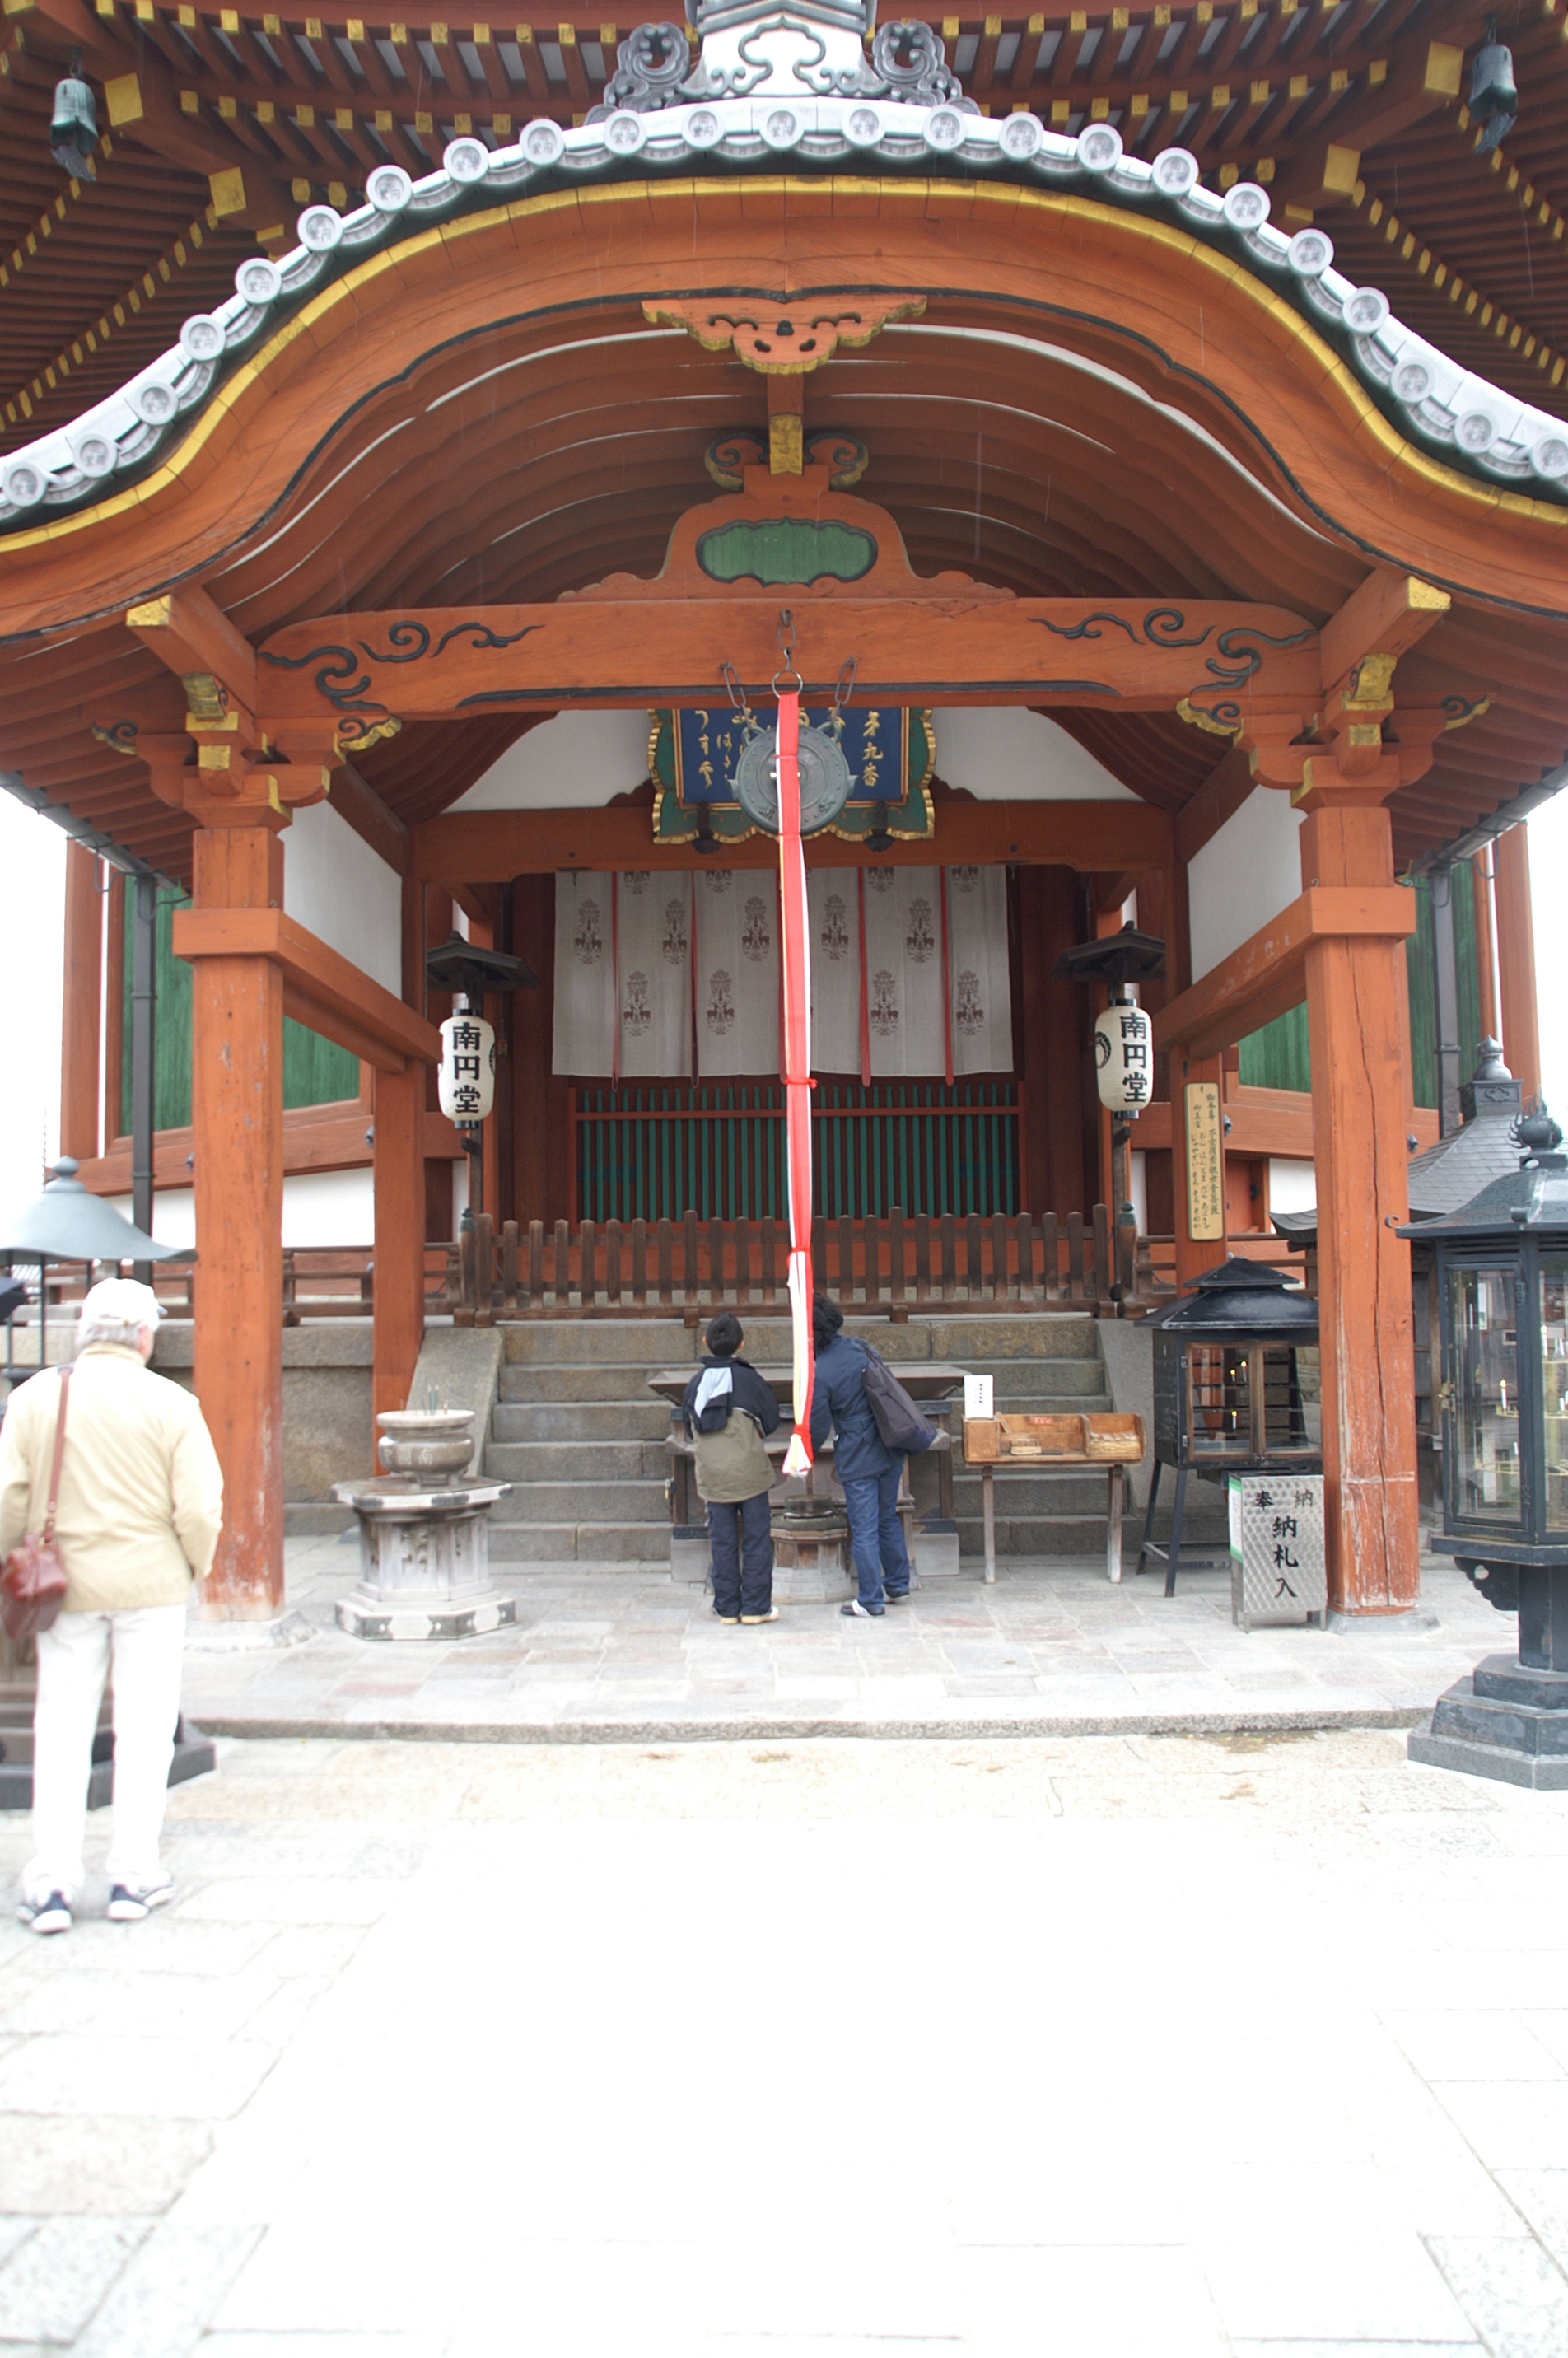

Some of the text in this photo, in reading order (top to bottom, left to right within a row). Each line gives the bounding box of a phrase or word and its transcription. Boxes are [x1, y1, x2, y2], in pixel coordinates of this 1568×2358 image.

[452, 1021, 481, 1114] 南円堂
[1120, 1011, 1148, 1104] 南円堂
[1272, 1515, 1299, 1599] 納札入
